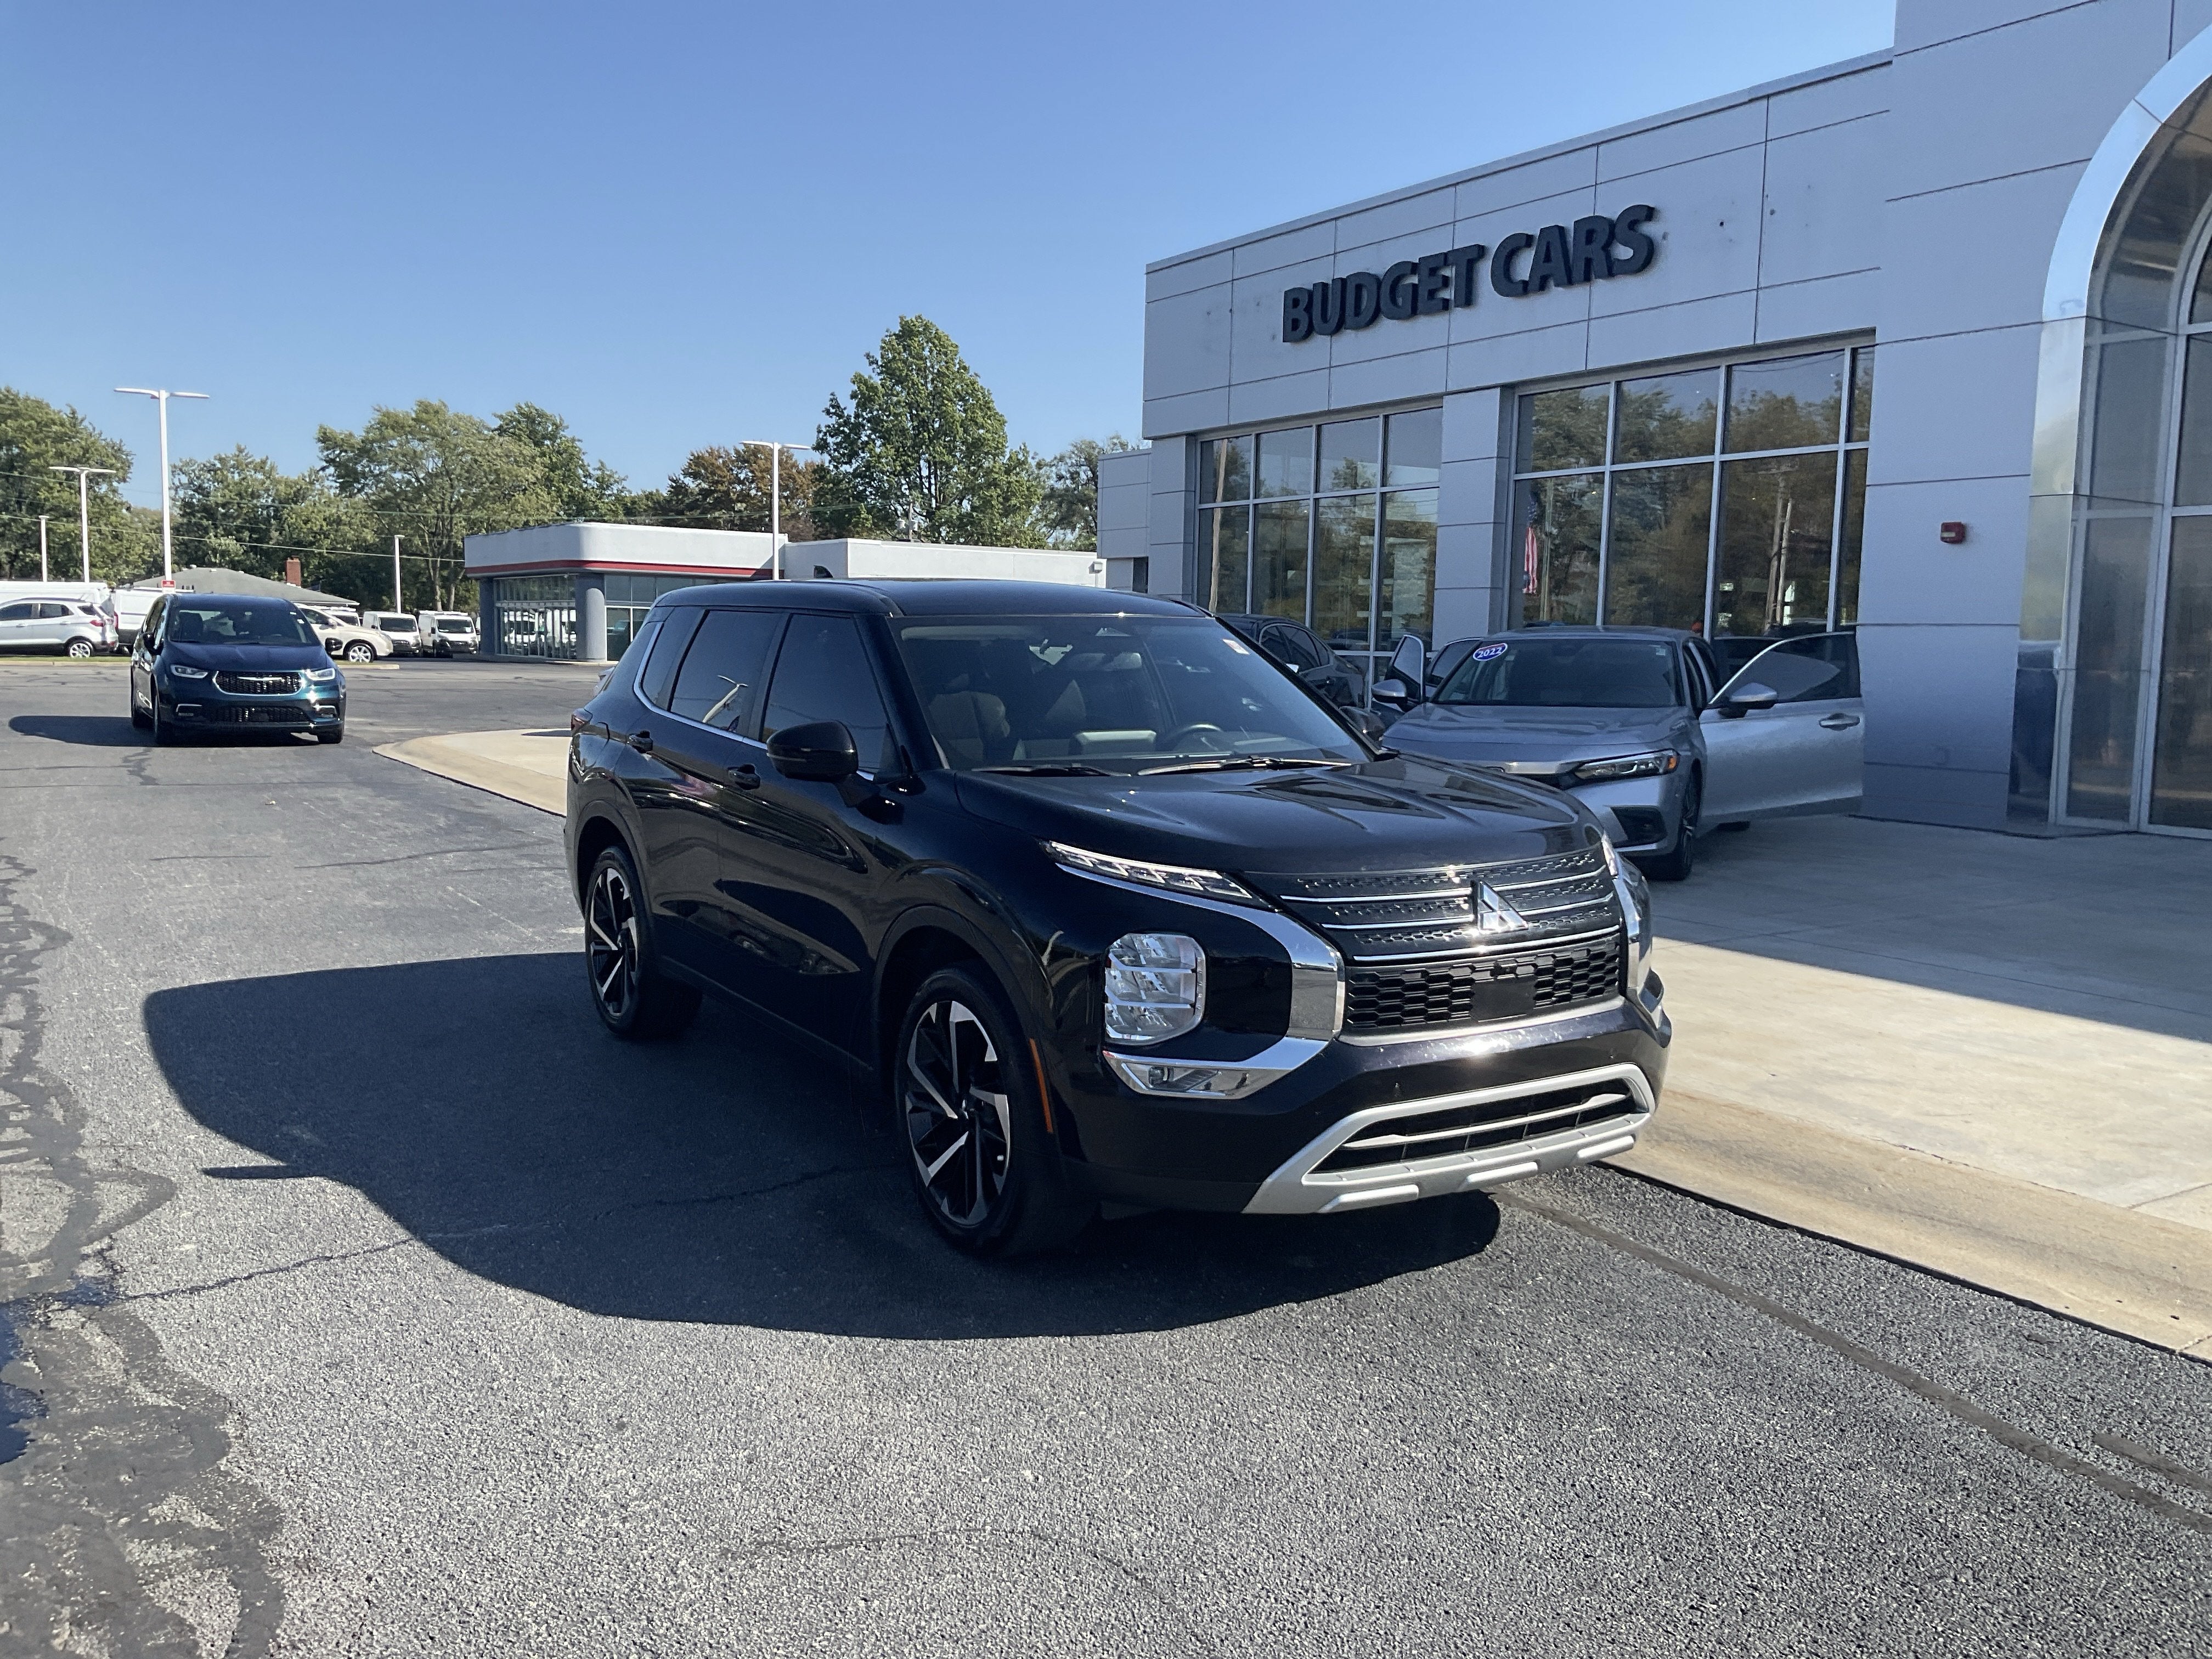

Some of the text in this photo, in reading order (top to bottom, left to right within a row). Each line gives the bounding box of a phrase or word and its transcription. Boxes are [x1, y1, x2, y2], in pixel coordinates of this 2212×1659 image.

[1283, 204, 1655, 342] BUDGET CARS
[1477, 647, 1502, 658] 2022
